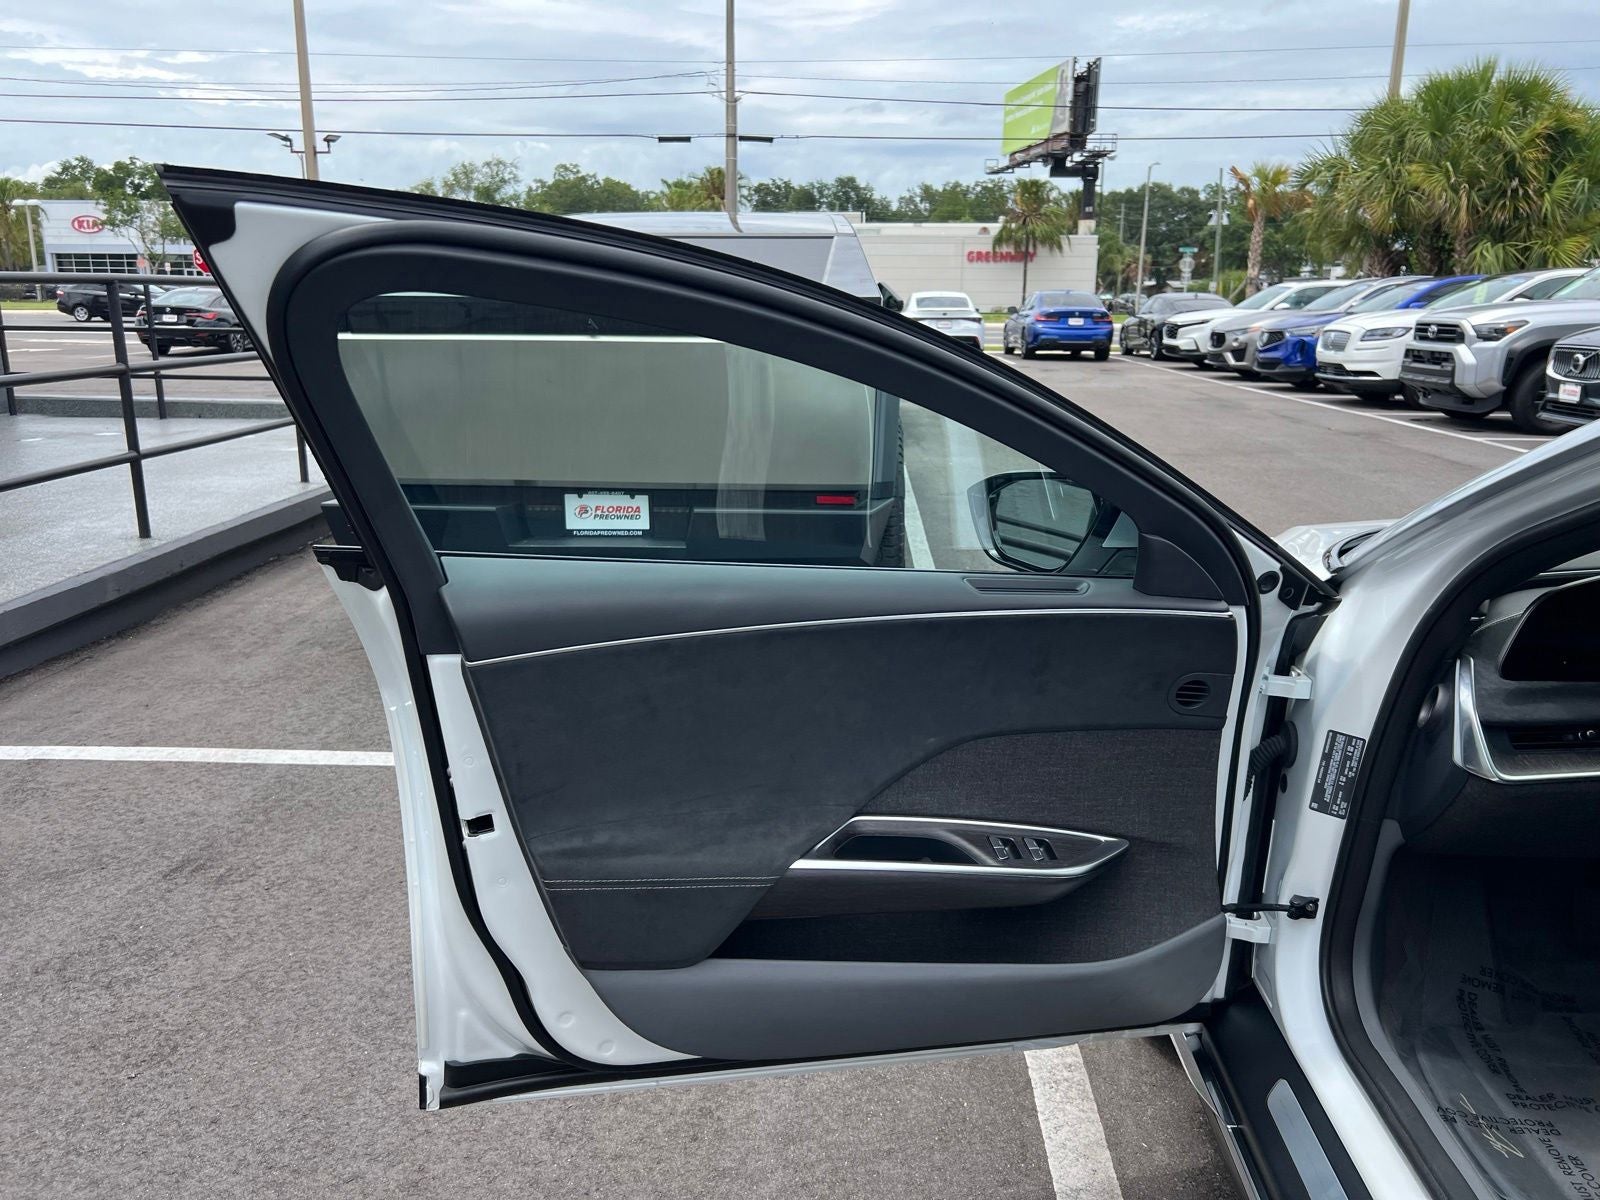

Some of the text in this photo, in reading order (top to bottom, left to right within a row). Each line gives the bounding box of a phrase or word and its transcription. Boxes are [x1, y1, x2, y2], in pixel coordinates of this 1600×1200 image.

[594, 505, 641, 513] FLORIDA
[1505, 1092, 1557, 1103] DEALER
[1509, 1126, 1562, 1136] DEALER
[1538, 1137, 1595, 1200] UST REMOVE
[1567, 1154, 1600, 1190] COVER
